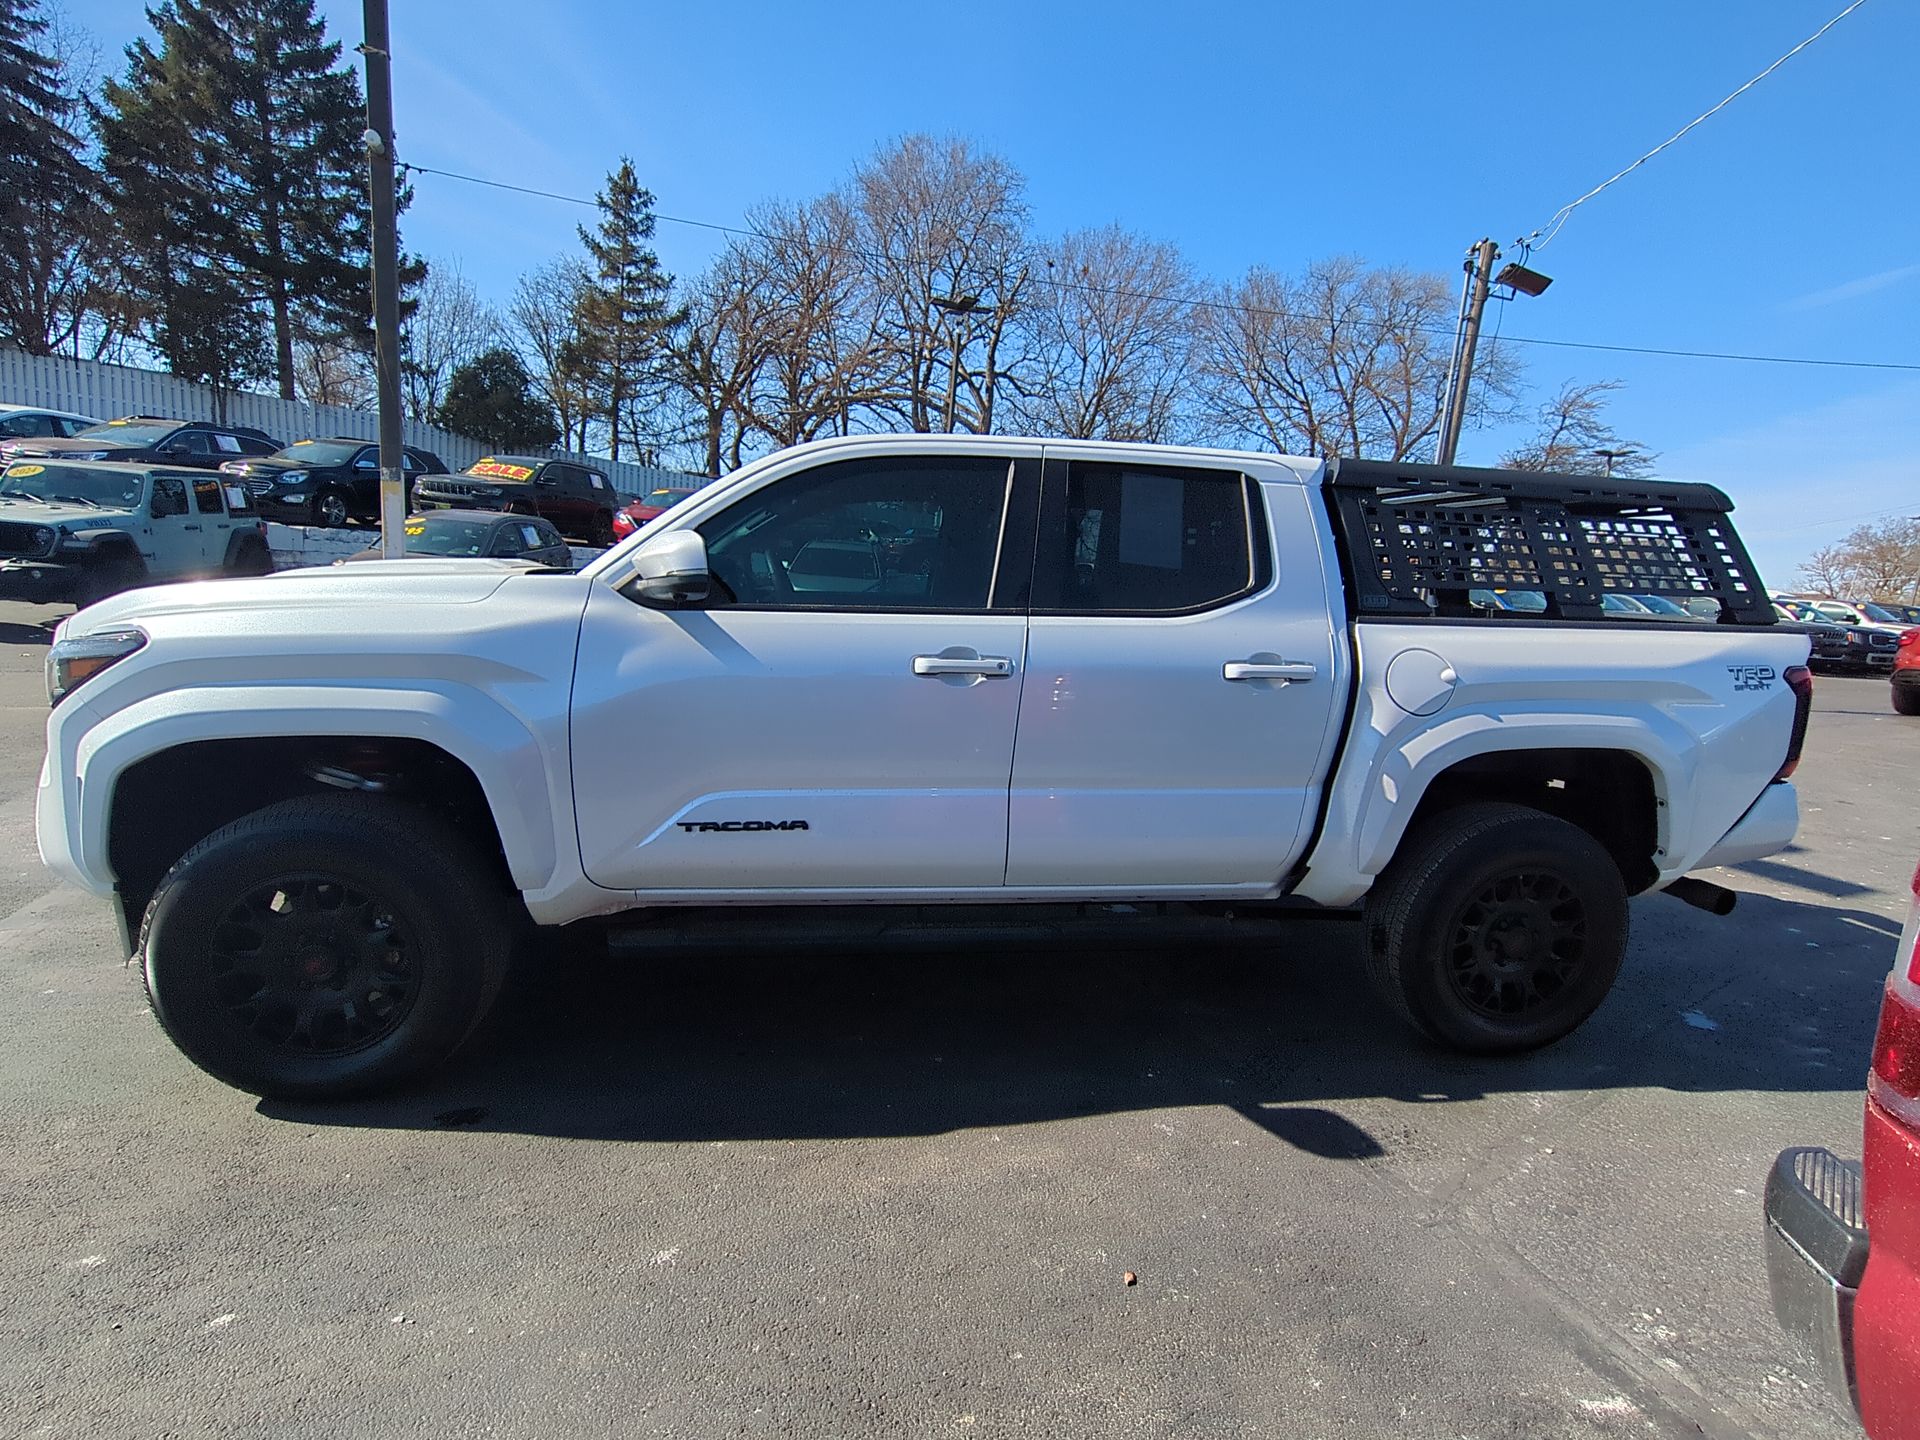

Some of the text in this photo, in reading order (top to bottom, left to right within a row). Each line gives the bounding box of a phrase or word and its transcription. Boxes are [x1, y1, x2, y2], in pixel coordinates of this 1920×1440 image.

[471, 464, 530, 479] SALE
[1727, 665, 1776, 684] TRD
[1734, 683, 1771, 691] SPORT
[677, 820, 809, 832] TACOMA
